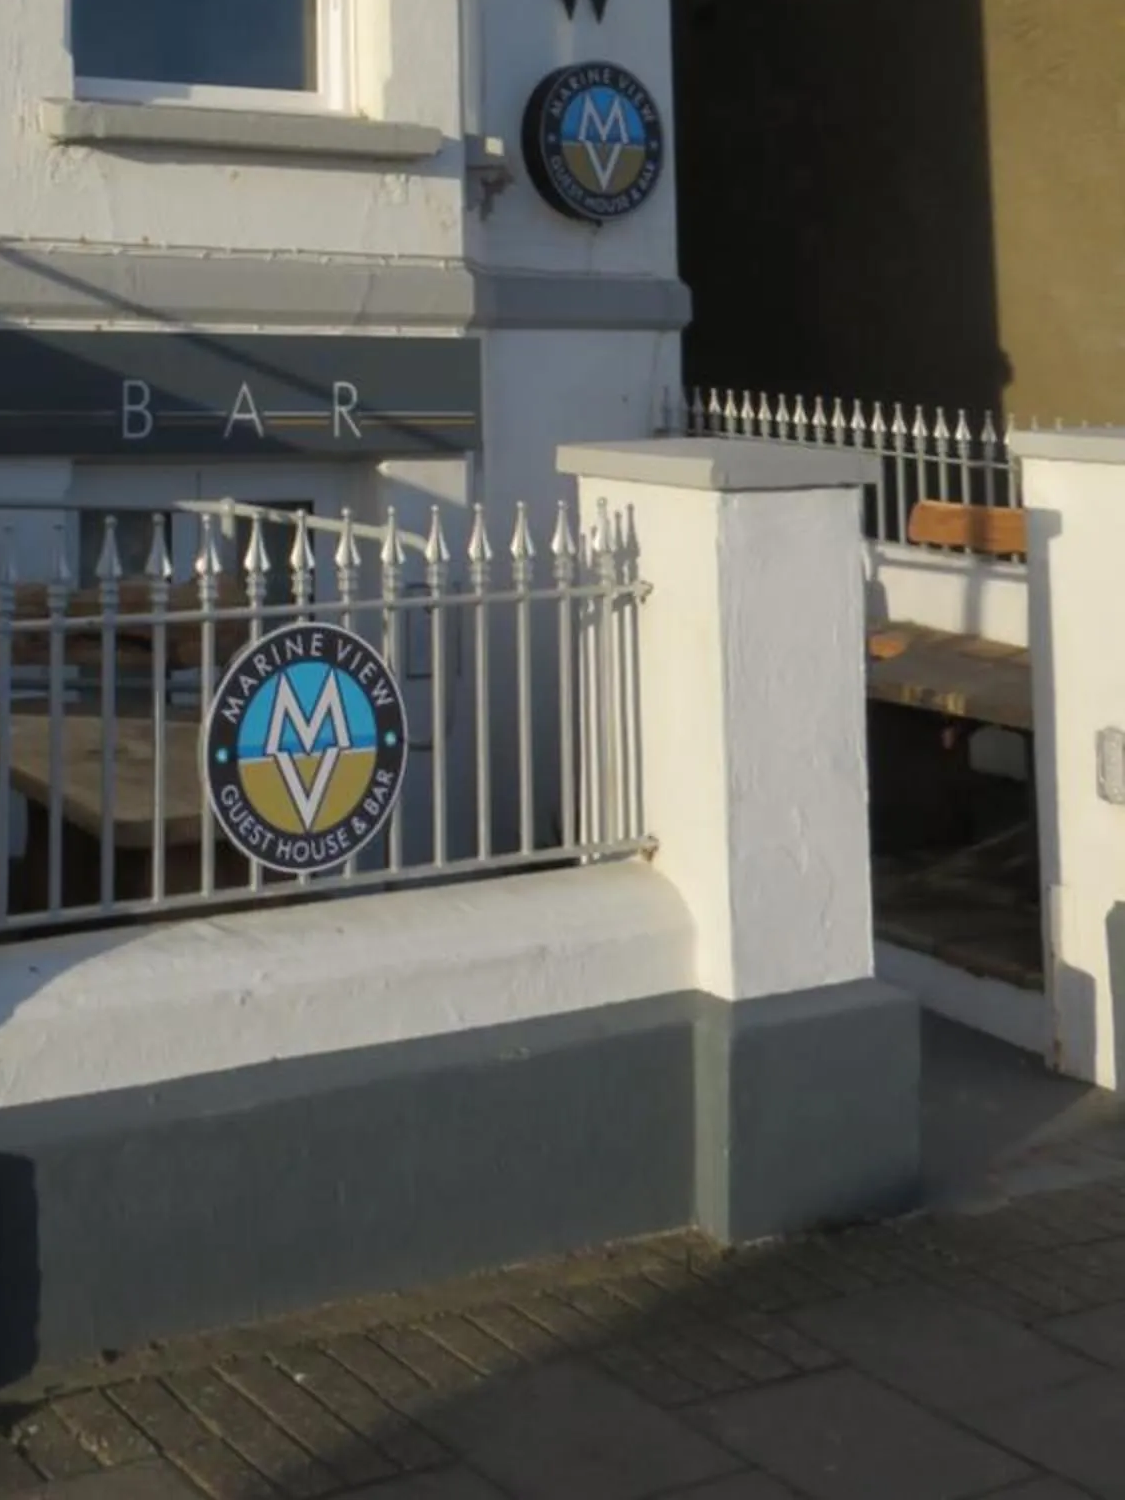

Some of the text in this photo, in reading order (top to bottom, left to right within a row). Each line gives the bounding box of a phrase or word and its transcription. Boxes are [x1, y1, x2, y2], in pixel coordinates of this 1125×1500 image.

[550, 67, 610, 118] MARINE
[121, 378, 362, 440] BAR
[220, 632, 393, 724] MARINE VIEW
[220, 769, 394, 864] GUEST HOUSE & BAR
